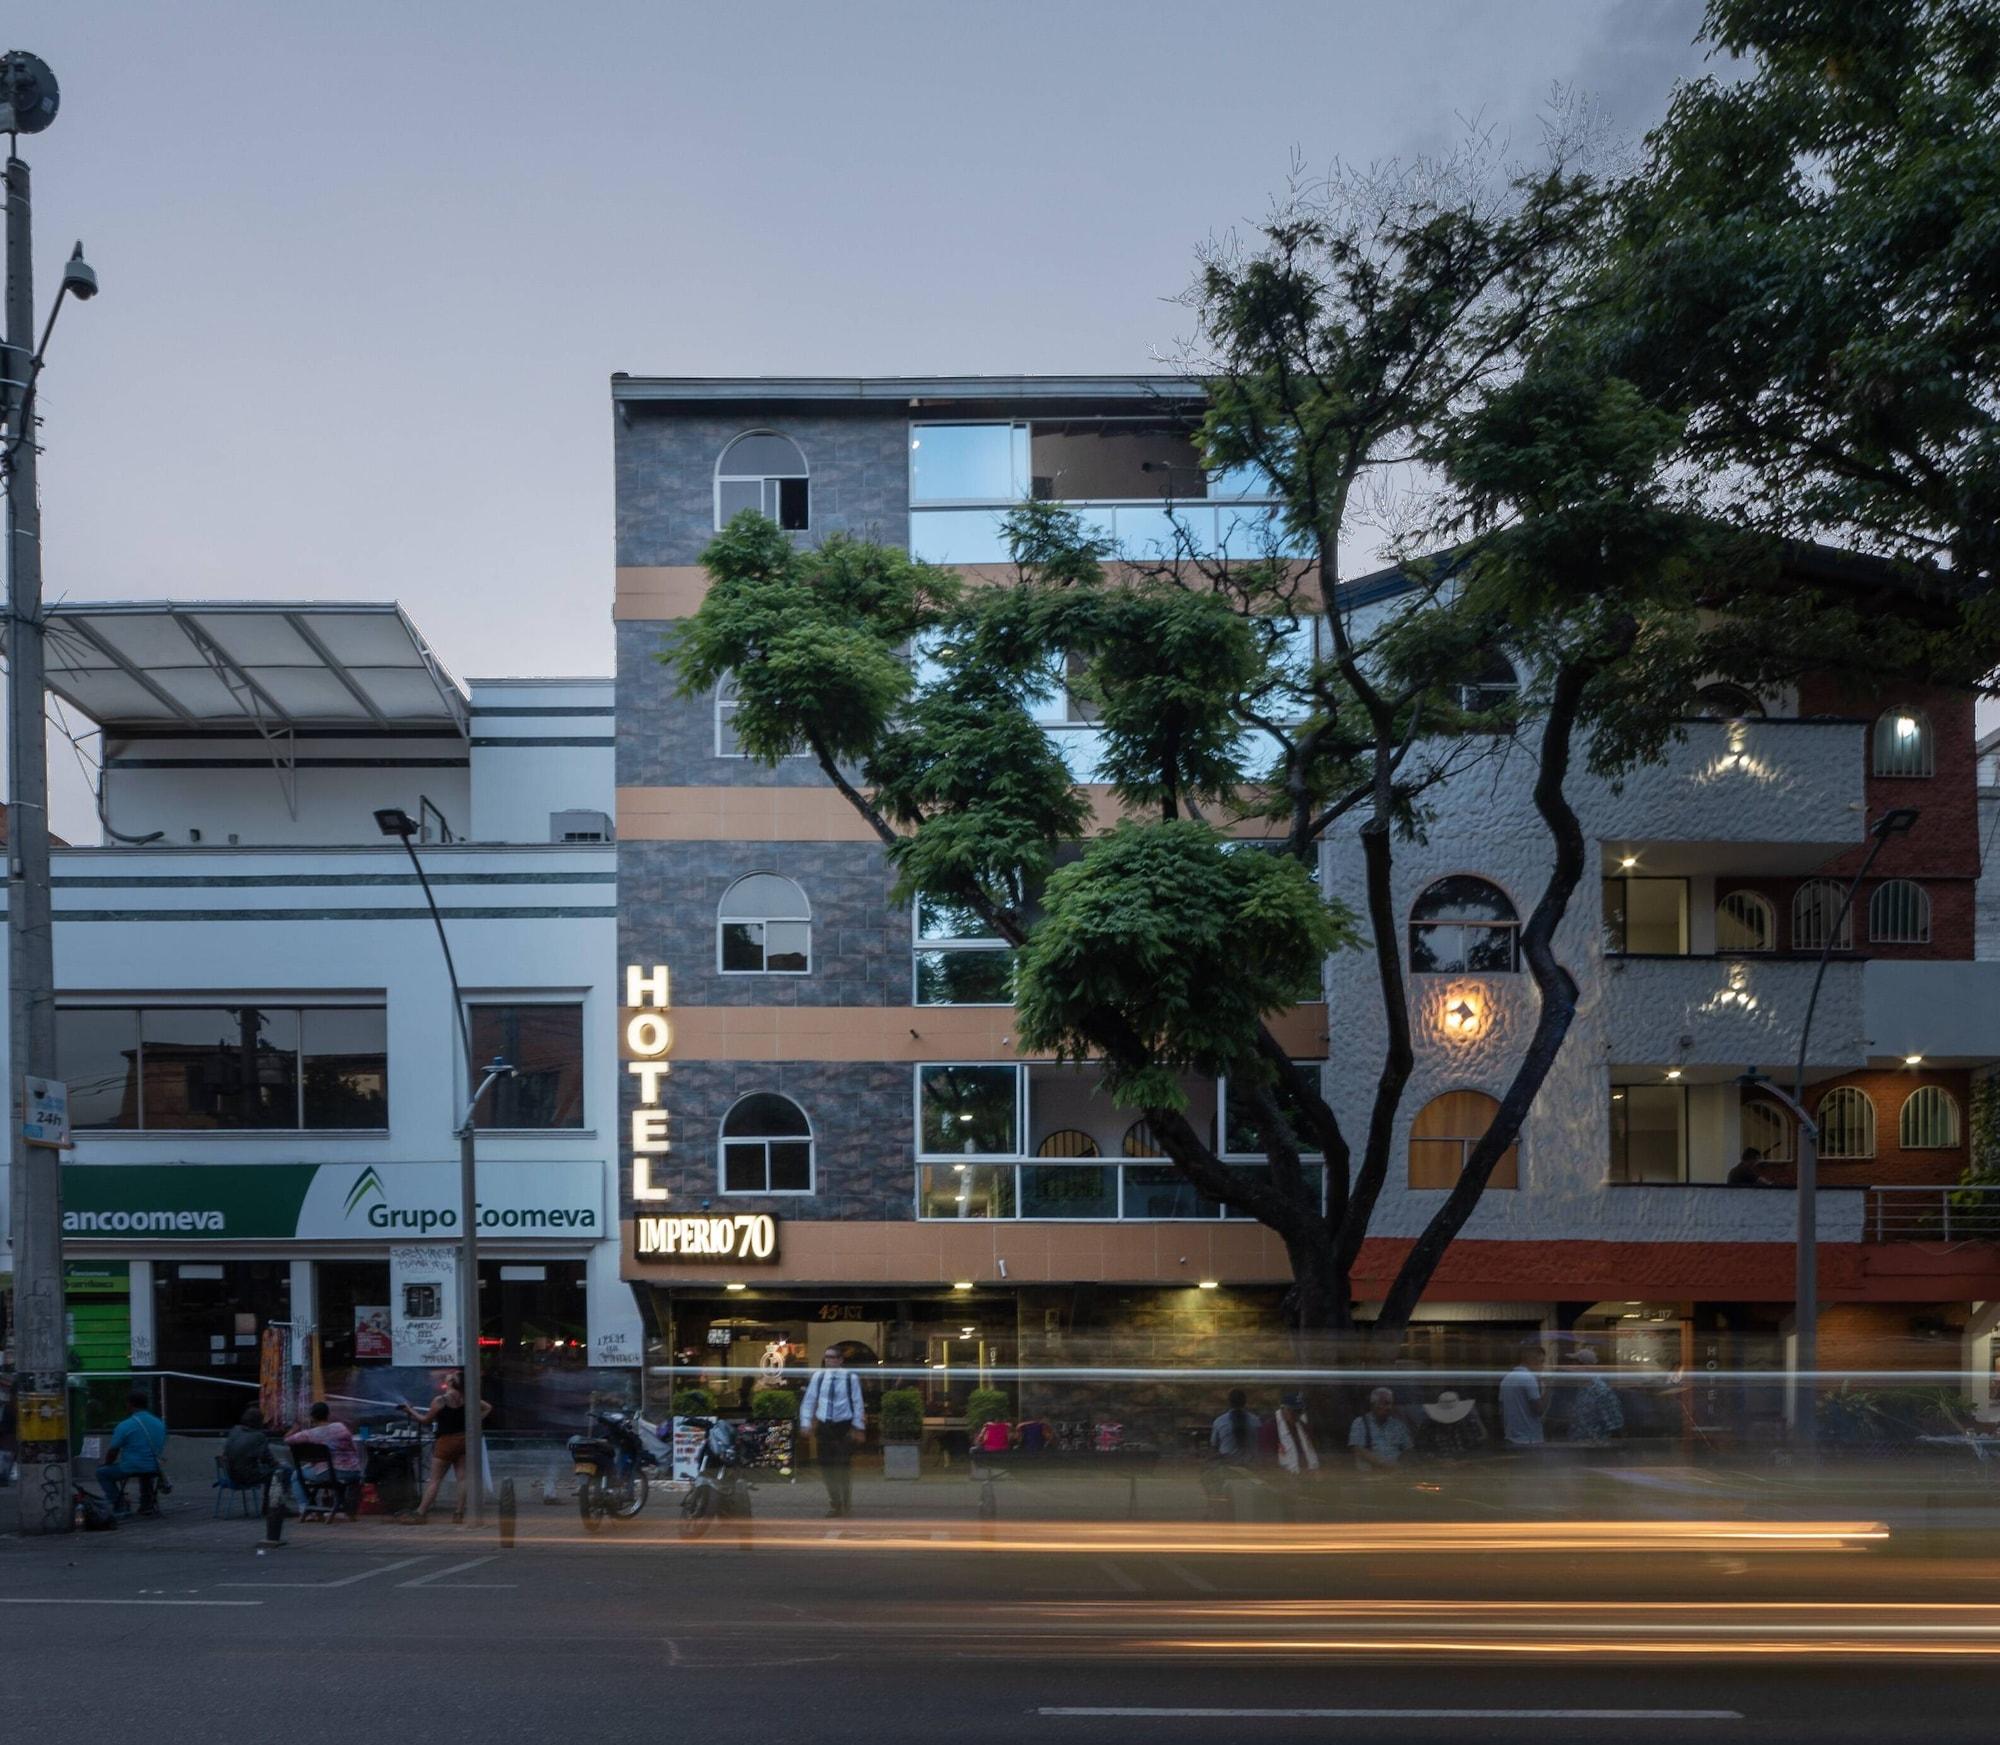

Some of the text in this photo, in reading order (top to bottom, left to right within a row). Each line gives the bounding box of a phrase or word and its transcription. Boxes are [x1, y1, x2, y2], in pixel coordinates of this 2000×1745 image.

[627, 965, 670, 1200] HOTEL
[62, 1210, 225, 1231] ancoomeva
[368, 1203, 457, 1234] Grupo
[638, 1214, 776, 1258] IMPERIO 70
